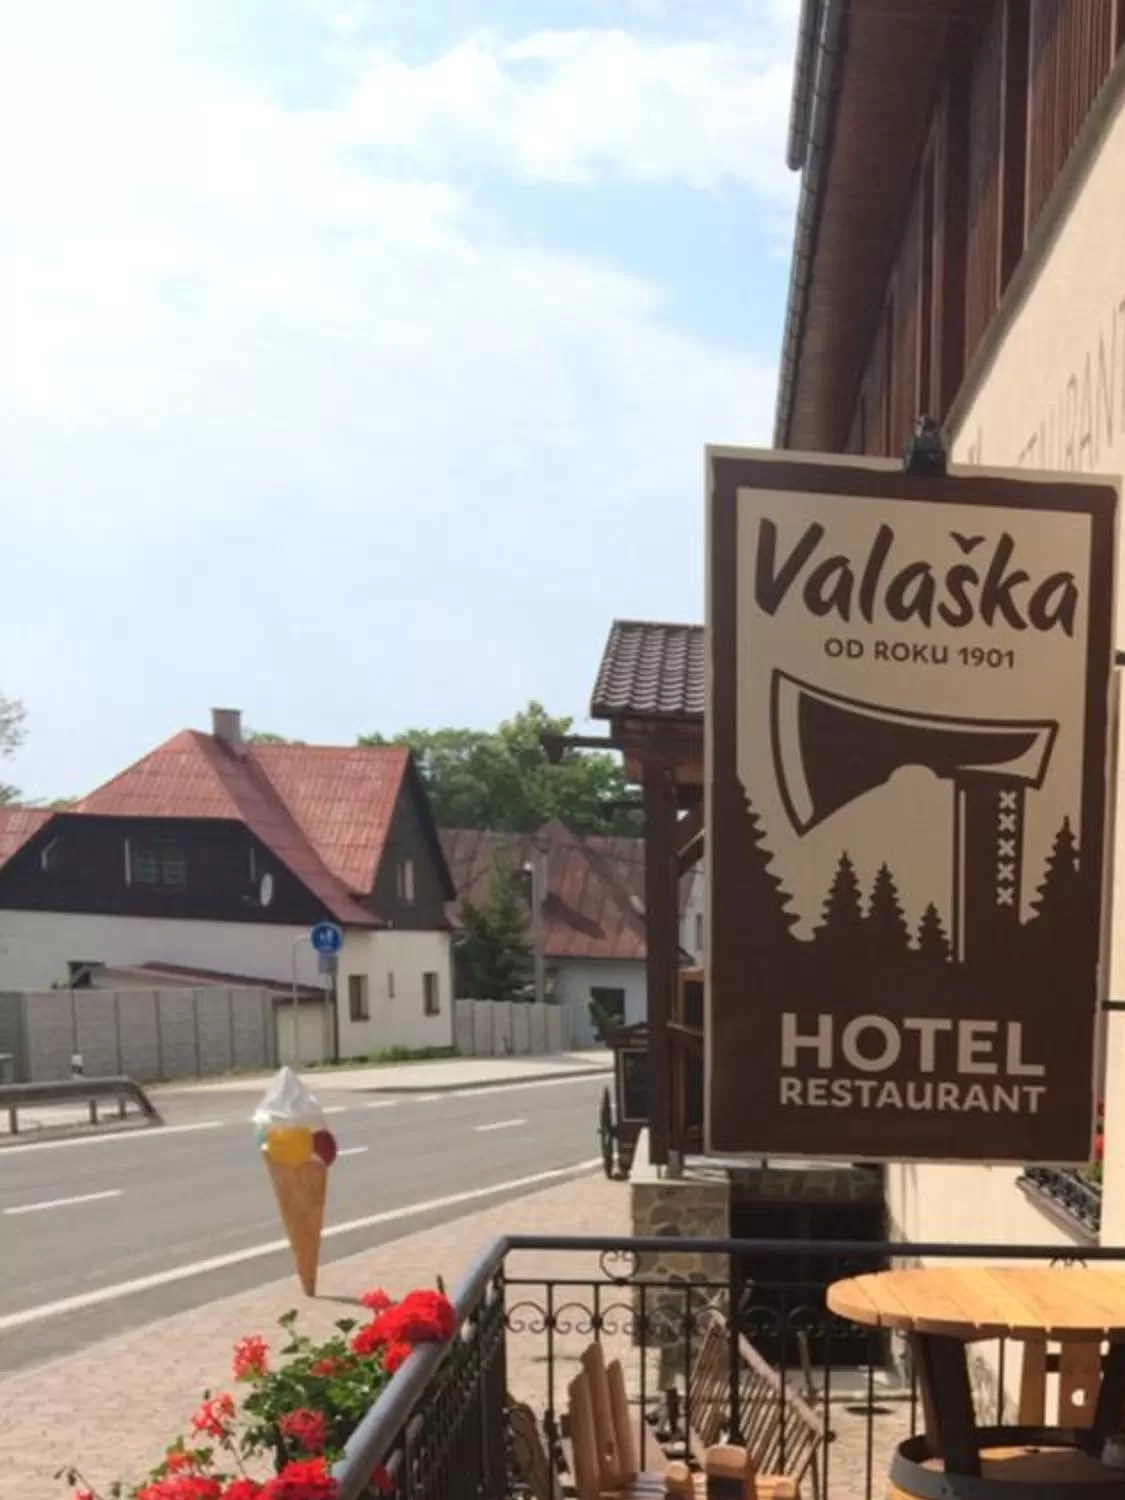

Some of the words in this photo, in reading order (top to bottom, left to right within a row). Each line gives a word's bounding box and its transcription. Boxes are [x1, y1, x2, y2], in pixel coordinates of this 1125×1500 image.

[754, 517, 1079, 639] Valaška
[824, 637, 865, 660] OD
[874, 641, 948, 665] ROKU
[958, 646, 1015, 669] 1901
[780, 1012, 1046, 1077] HOTEL
[779, 1076, 1047, 1114] RESTAURANT
